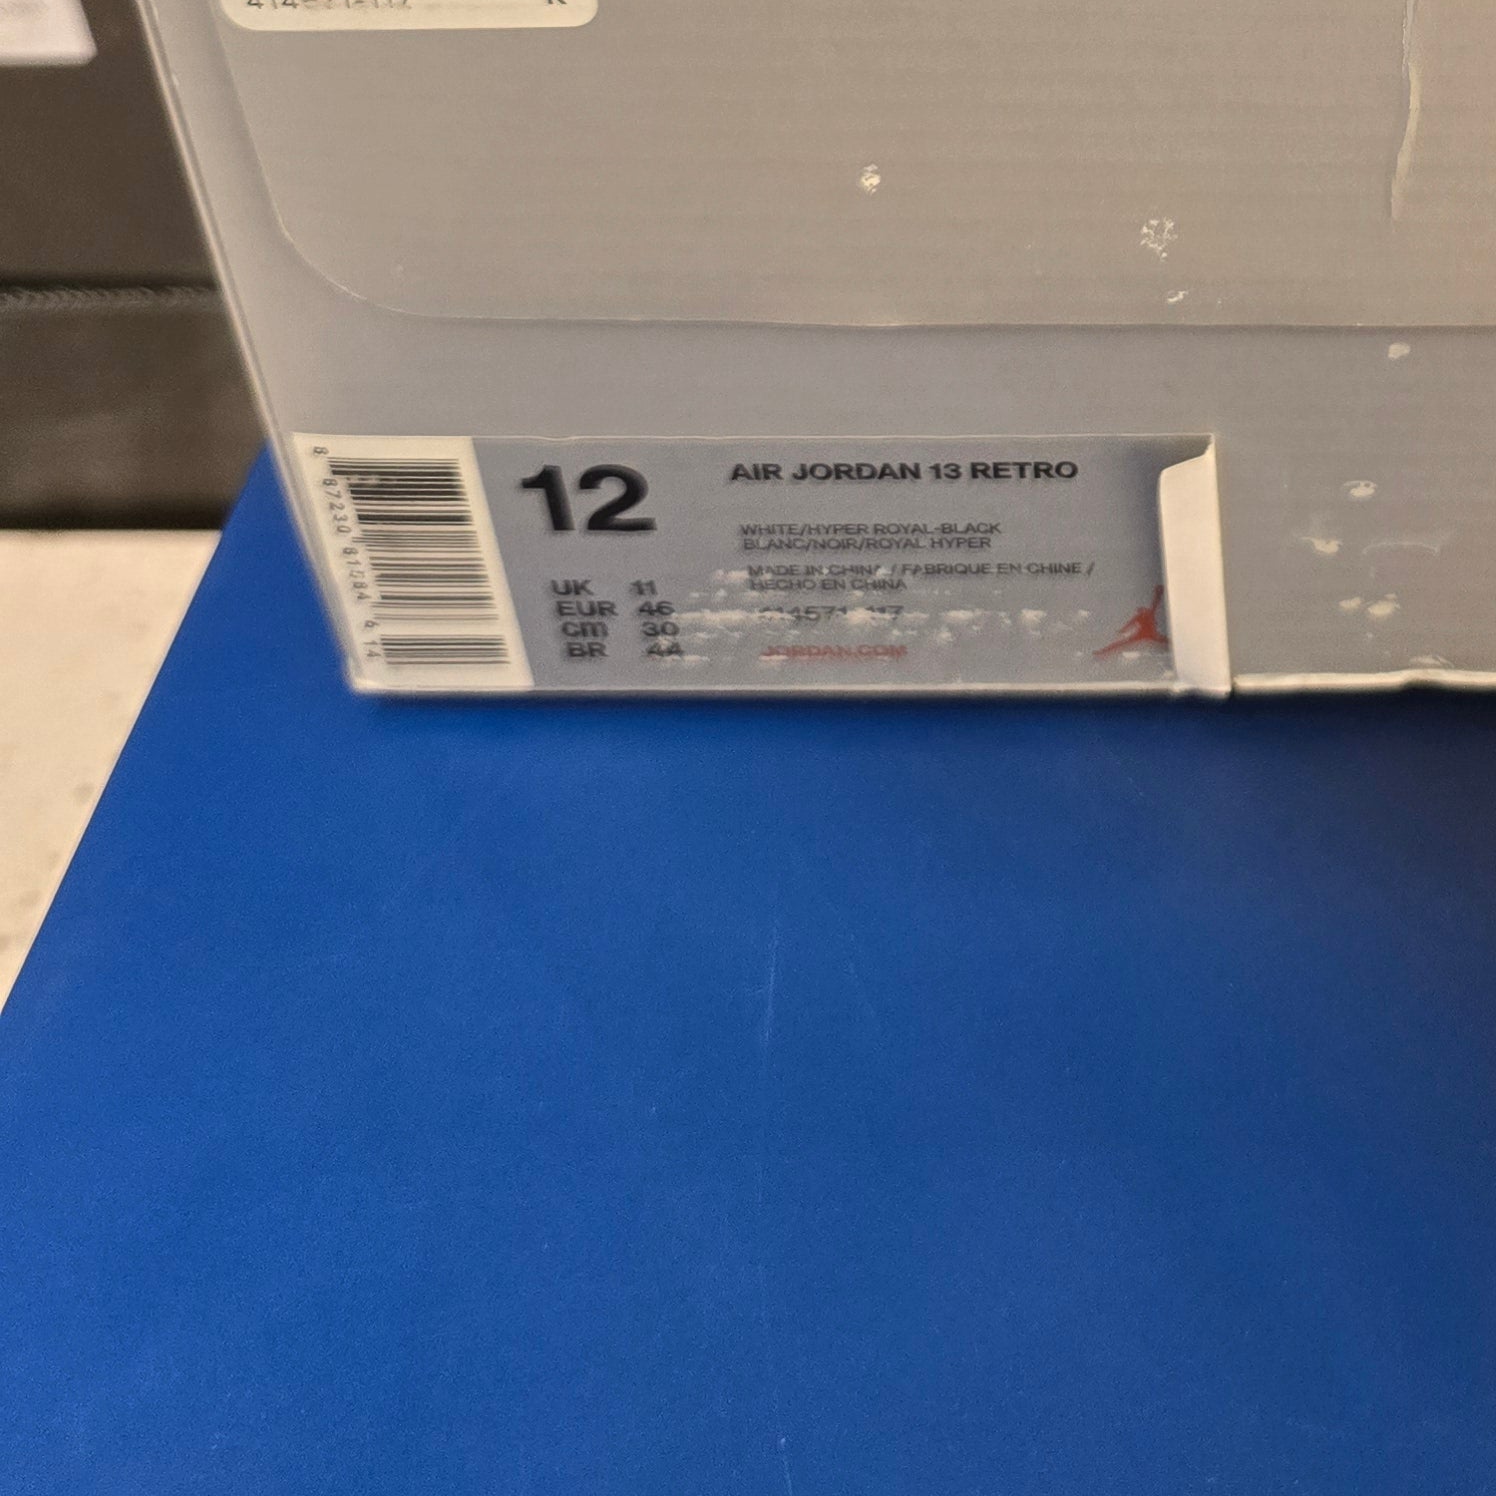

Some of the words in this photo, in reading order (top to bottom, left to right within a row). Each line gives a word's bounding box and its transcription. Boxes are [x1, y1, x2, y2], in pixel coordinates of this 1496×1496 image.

[731, 463, 783, 481] AIR
[792, 462, 921, 480] JORDAN
[928, 462, 962, 479] 13
[970, 461, 1078, 480] RETRO
[521, 463, 657, 531] 12
[739, 523, 869, 536] WHITE/HYPER
[873, 522, 1001, 535] ROYAL-BLACK
[743, 537, 926, 551] BLANC/NOIR/ROYAL
[931, 537, 991, 549] HYPER
[748, 564, 801, 576] MADE
[805, 565, 823, 576] IN
[902, 563, 992, 576] FABRIQUE
[997, 563, 1022, 574] EN
[1026, 562, 1082, 574] CHINE
[551, 579, 594, 596] UK
[631, 579, 658, 595] 11
[751, 579, 816, 591] HECHO
[822, 579, 846, 590] EN
[851, 579, 907, 590] CHINA
[556, 600, 618, 617] EUR
[639, 601, 675, 616] 46
[643, 622, 680, 637] 30
[567, 641, 608, 657] BR
